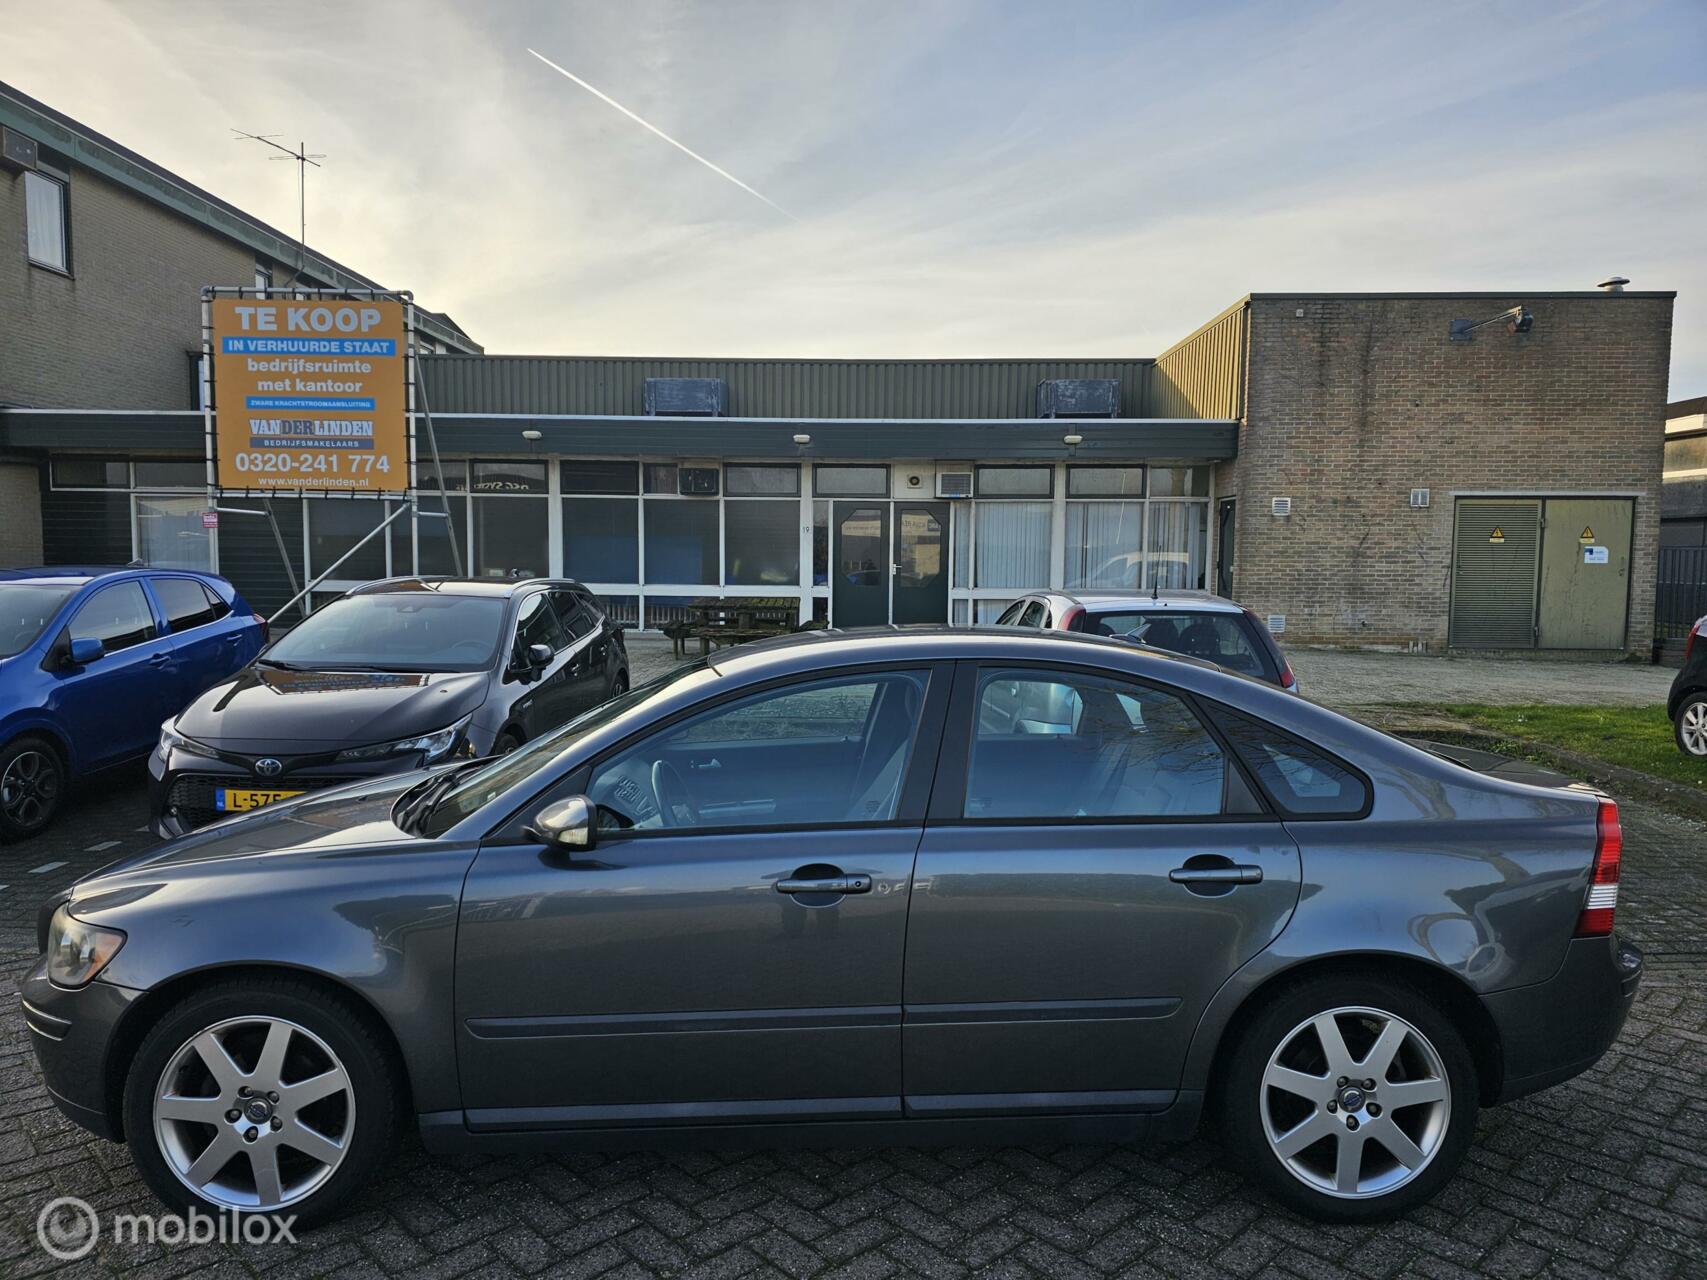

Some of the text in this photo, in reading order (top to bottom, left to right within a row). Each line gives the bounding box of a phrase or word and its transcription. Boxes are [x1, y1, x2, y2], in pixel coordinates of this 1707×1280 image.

[235, 307, 381, 332] TE KOOP
[228, 340, 389, 353] IN VERHUURDE STAAT
[247, 358, 372, 374] bedrijfsruimte
[257, 379, 363, 393] met kantoor
[249, 419, 374, 436] VANDERLINDEN
[264, 440, 359, 448] BEDRIJFSMAKELAARS
[235, 453, 390, 473] 0320-241 774
[258, 477, 369, 487] www.vanderlinden.nl
